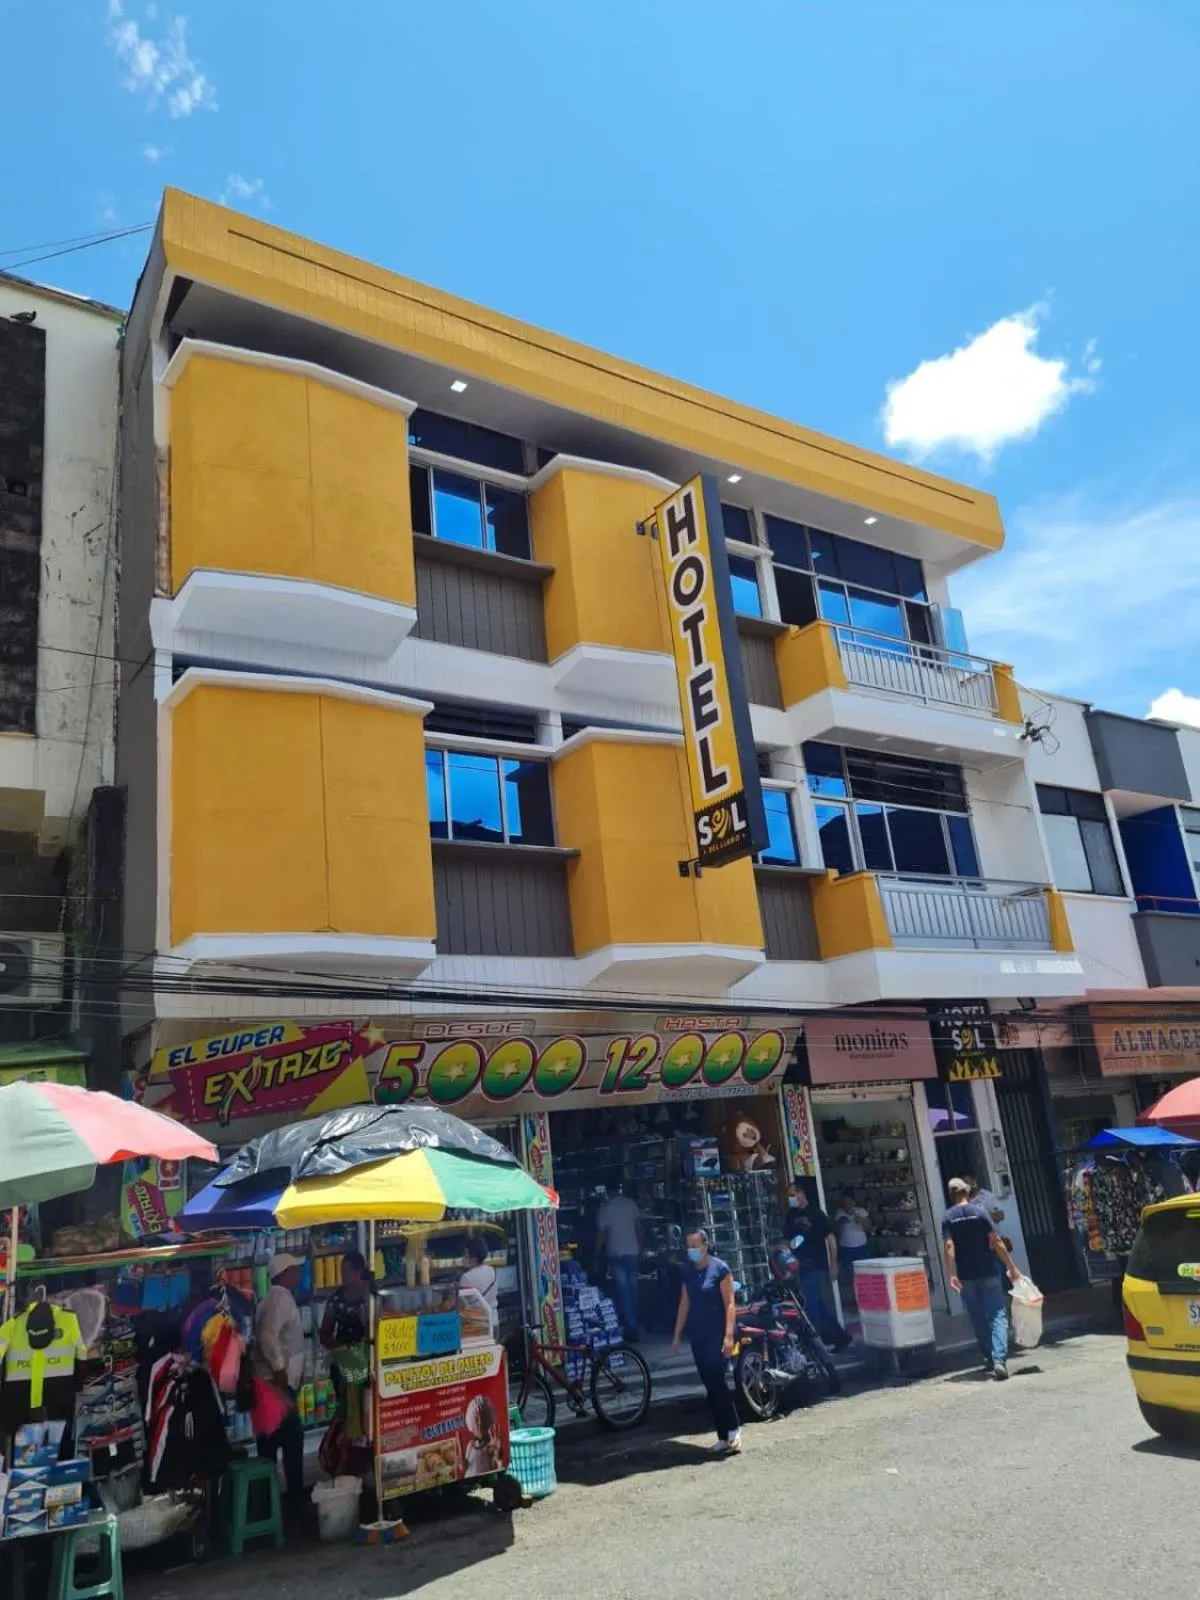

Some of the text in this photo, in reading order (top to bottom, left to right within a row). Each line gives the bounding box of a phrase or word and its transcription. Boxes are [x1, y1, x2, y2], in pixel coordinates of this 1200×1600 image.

[664, 489, 730, 797] HOTEL
[424, 1021, 523, 1037] DESDE
[664, 1017, 741, 1031] HASTA
[835, 1026, 909, 1052] monitas
[168, 1025, 285, 1067] EL SUPER
[599, 1029, 785, 1095] 12.000
[374, 1034, 588, 1106] 5.000
